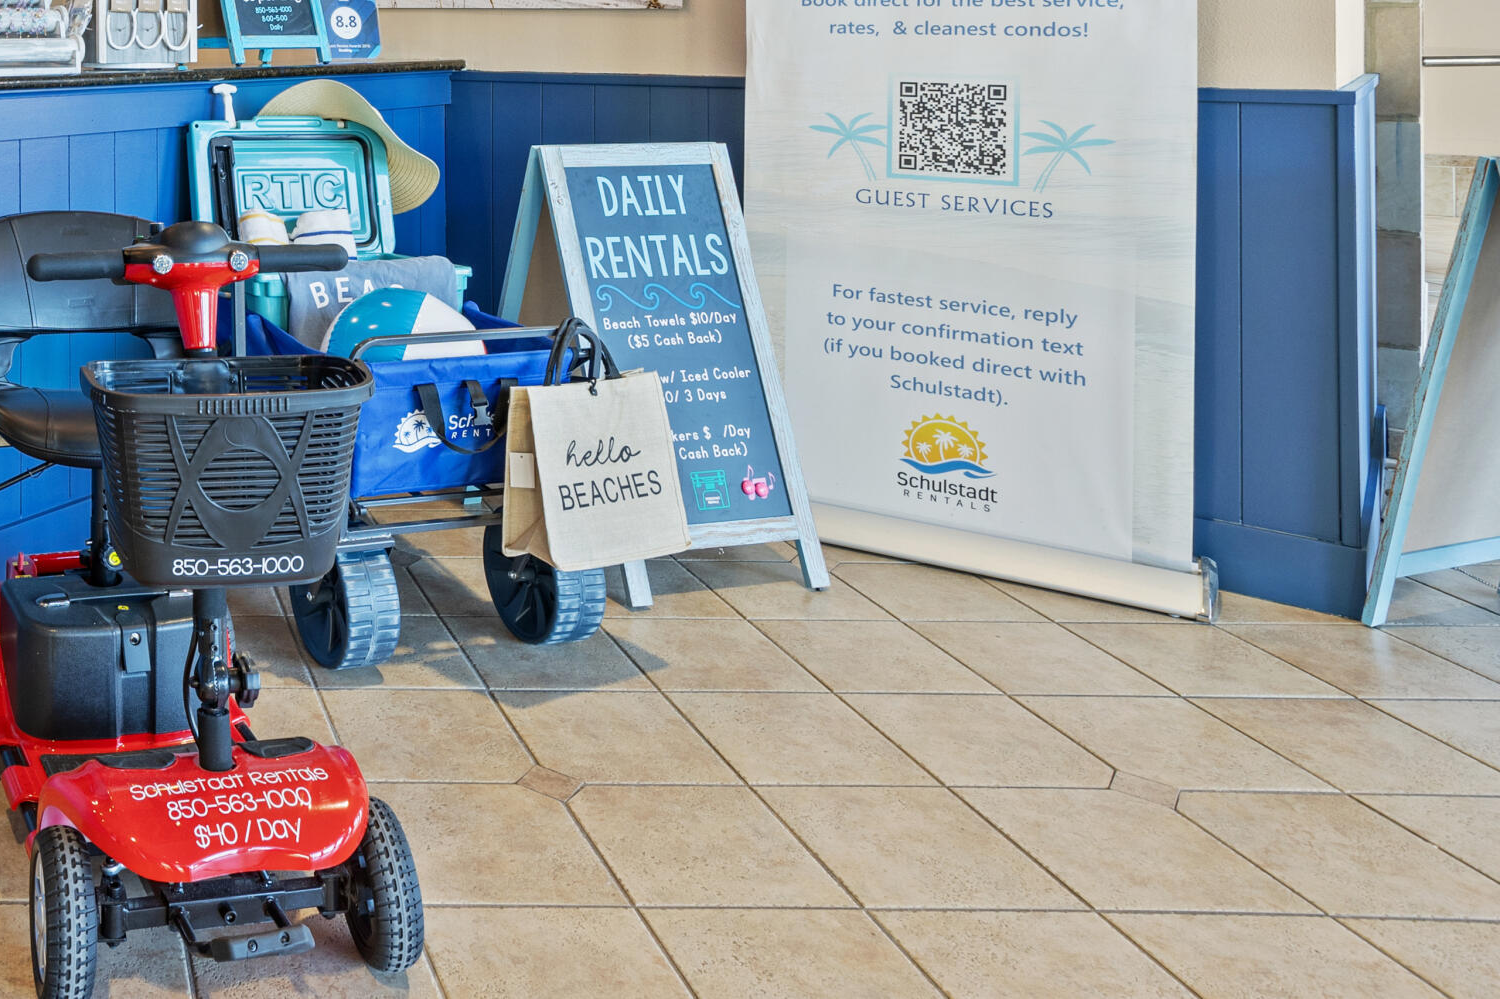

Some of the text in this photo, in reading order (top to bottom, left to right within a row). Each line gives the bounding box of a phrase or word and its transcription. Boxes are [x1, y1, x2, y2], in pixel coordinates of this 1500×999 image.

[335, 15, 357, 28] 8.8
[829, 20, 1089, 38] rates, & cleanest condos!
[241, 172, 344, 210] RTIC
[596, 174, 685, 217] DAILY
[855, 188, 1054, 219] GUEST SERVICES
[585, 232, 729, 279] RENTALS
[603, 310, 737, 331] Beach Towels $10/Day
[832, 283, 1078, 329] For fastest service, reply
[628, 329, 722, 350] ($5 Cash Back)
[826, 310, 1085, 358] to your confirmation text
[681, 369, 709, 383] Iced
[713, 367, 751, 380] Cooler
[823, 337, 1087, 387] (if you booked direct with
[685, 389, 693, 401] 3
[697, 388, 727, 403] Days
[889, 374, 1009, 407] Schulstadt).
[704, 425, 712, 440] $
[565, 436, 641, 468] hello
[679, 442, 748, 460] Cash Back)
[558, 469, 662, 511] BEACHES
[897, 470, 998, 504] Schulstadt
[903, 489, 991, 513] RENTALS
[172, 555, 304, 576] 850-563-1000
[130, 766, 329, 802] Schulstadt Rentals
[166, 786, 312, 821] 850-563-1000
[194, 822, 239, 850] $40
[259, 817, 301, 844] Day
